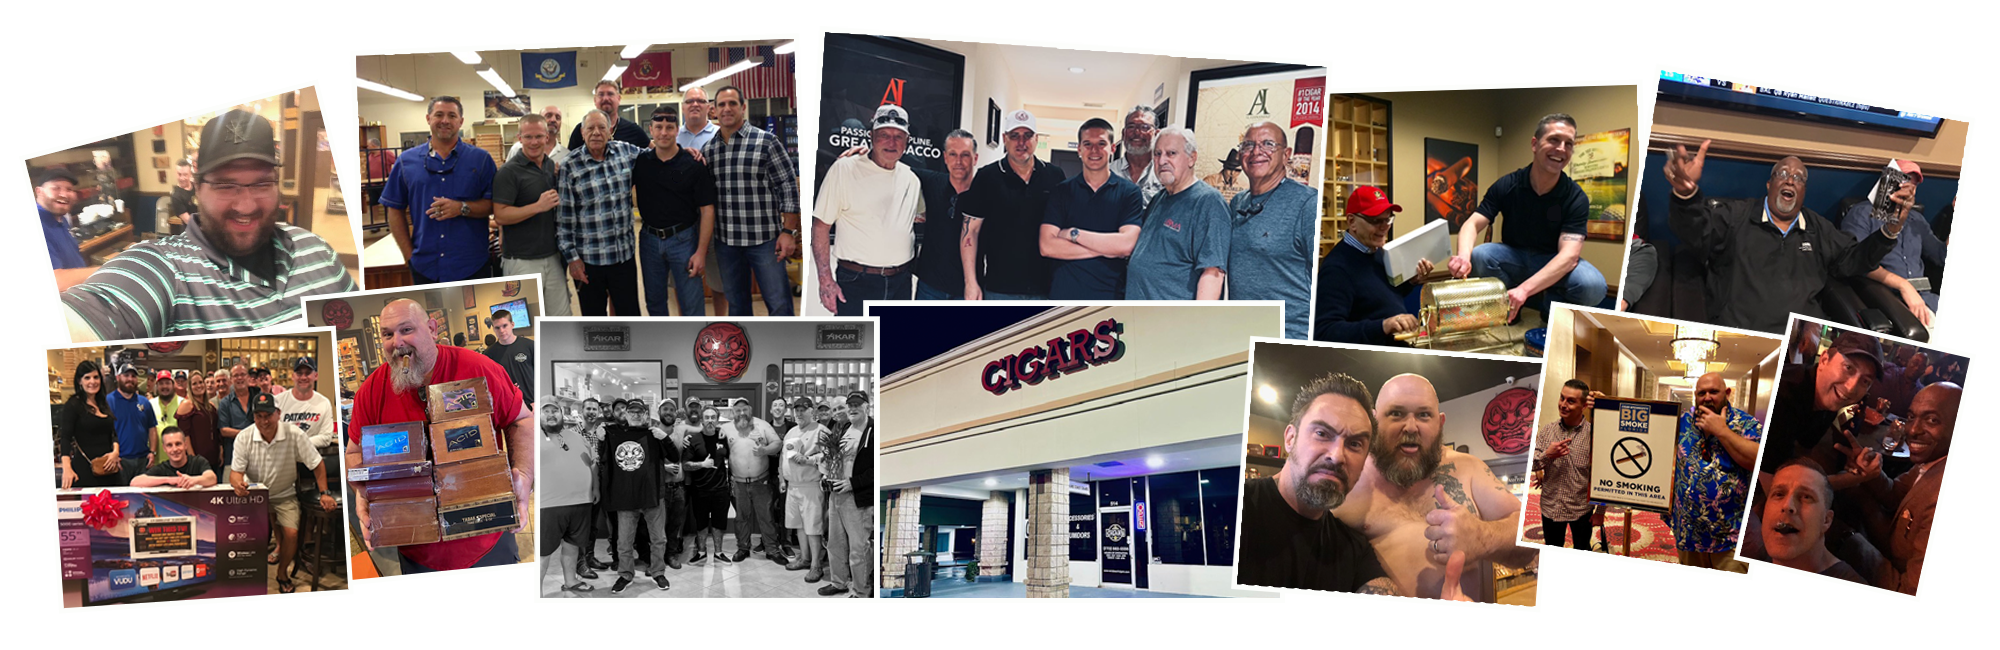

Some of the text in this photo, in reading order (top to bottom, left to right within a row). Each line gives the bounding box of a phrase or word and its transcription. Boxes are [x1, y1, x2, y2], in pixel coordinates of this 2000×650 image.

[1305, 87, 1322, 97] CIGAR
[1296, 101, 1320, 115] 2014
[840, 126, 933, 147] PASSIO PLINE,
[903, 145, 941, 159] ACCO
[981, 318, 1121, 395] CIGARS
[446, 391, 475, 410] ACID
[283, 412, 321, 422] PATRIOTS
[1621, 408, 1648, 422] BIG
[1620, 420, 1648, 429] SMOKE
[377, 434, 407, 451] ACID
[449, 428, 478, 448] ACID
[1593, 486, 1626, 495] PERMITTED
[1599, 479, 1661, 493] NO SMOKING
[210, 495, 264, 505] 4K Ultra HD
[1069, 514, 1095, 522] CESSORIES
[1069, 531, 1091, 539] UMIDORS
[113, 576, 133, 585] VUDU
